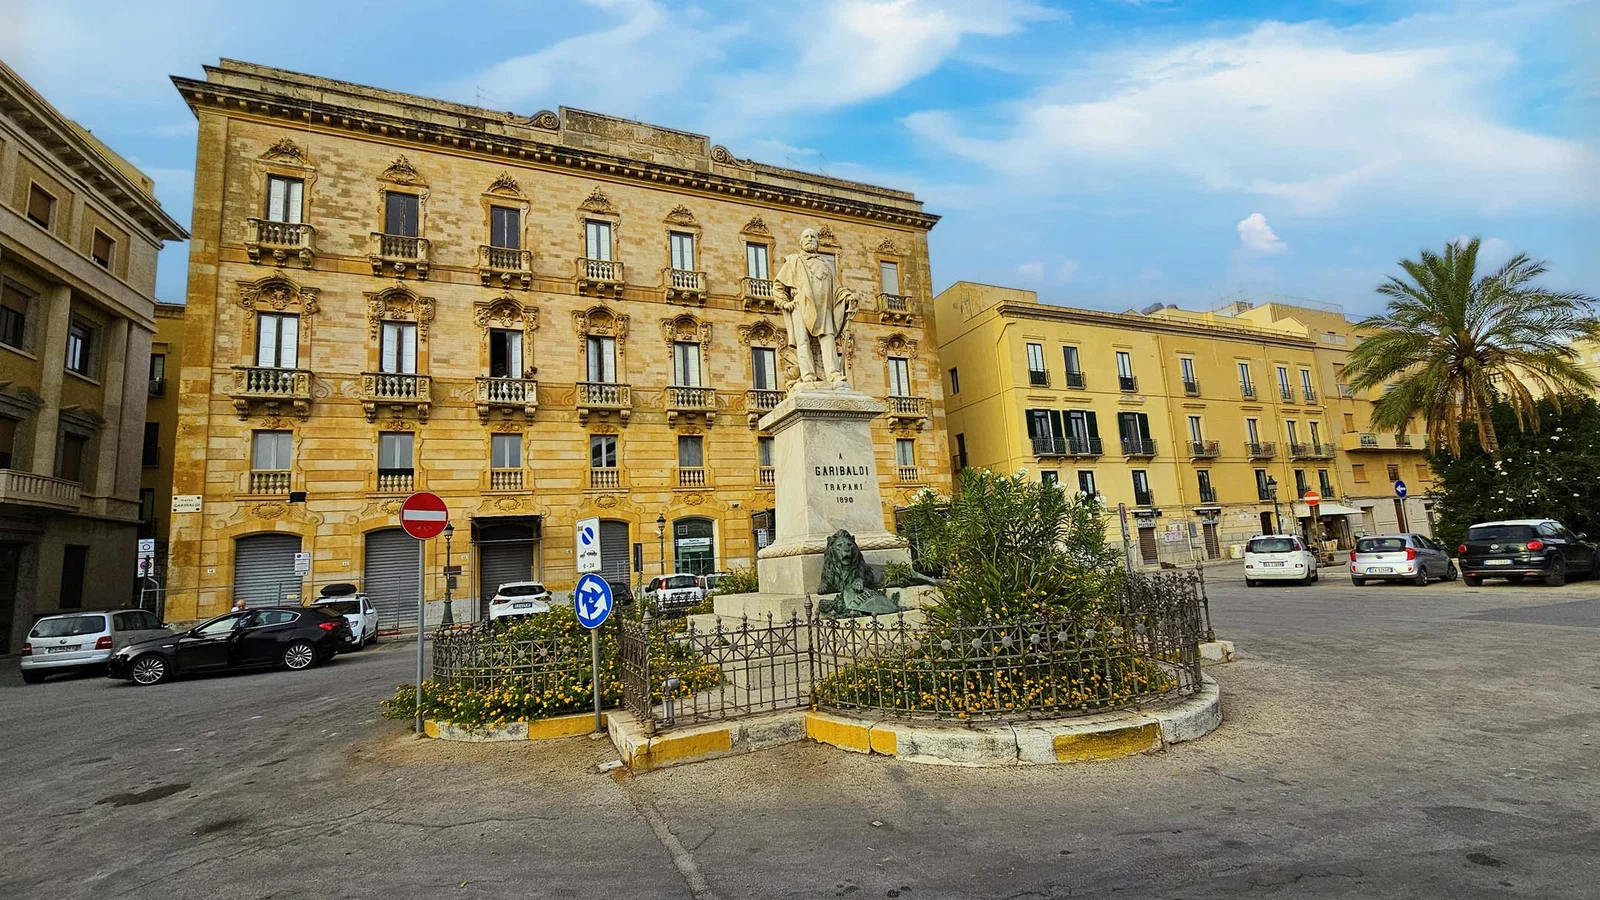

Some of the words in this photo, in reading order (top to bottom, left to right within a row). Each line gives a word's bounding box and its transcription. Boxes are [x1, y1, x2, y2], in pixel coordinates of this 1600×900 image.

[838, 452, 843, 460] A
[815, 466, 869, 476] GARIBALDI
[824, 483, 863, 491] TRAPANI
[836, 496, 854, 504] 1890
